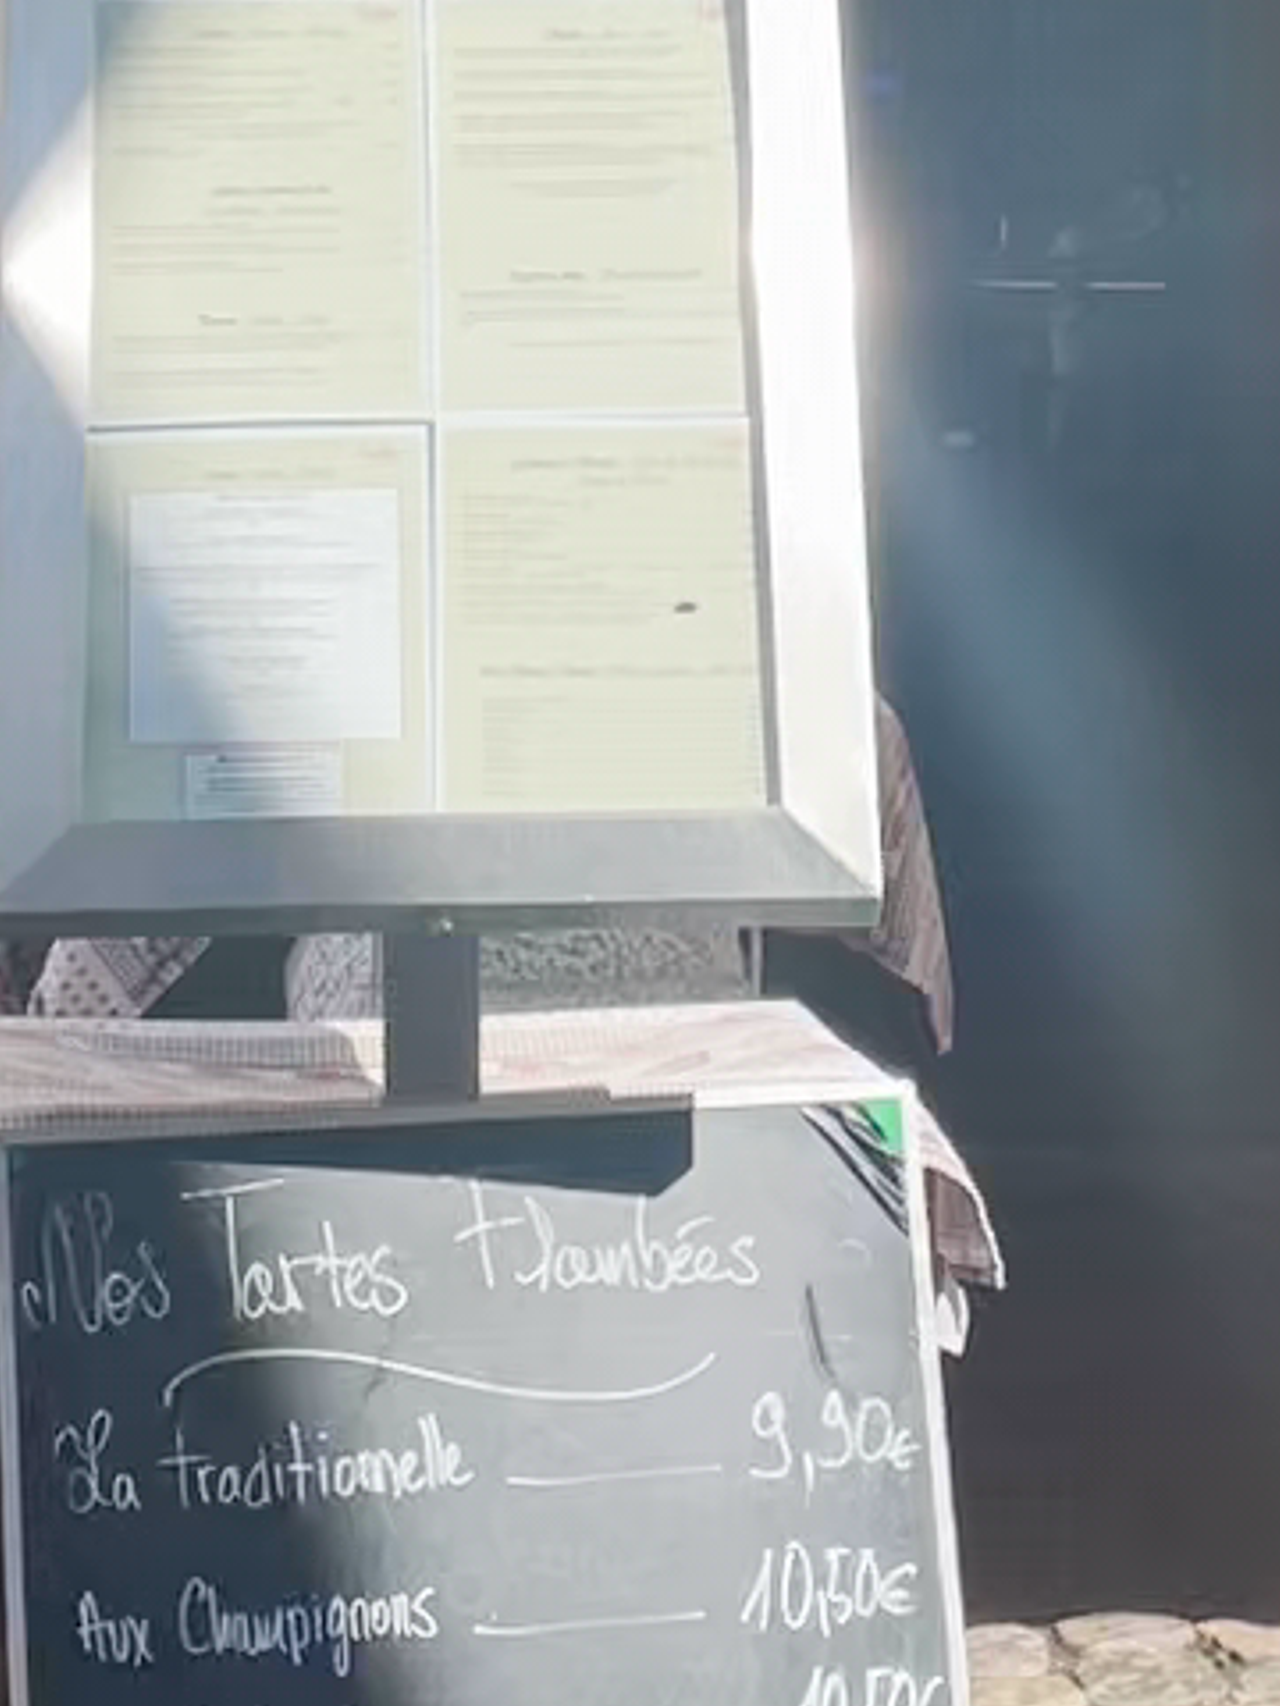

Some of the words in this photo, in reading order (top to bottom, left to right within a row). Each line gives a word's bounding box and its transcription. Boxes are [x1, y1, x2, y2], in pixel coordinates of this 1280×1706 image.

[21, 1191, 170, 1333] Nos
[180, 1178, 409, 1322] Tartes
[54, 1408, 142, 1514] La
[749, 1389, 922, 1496] 9,90€
[77, 1590, 154, 1667] Aux
[179, 1576, 440, 1677] Champignons
[739, 1540, 918, 1637] 10,50€
